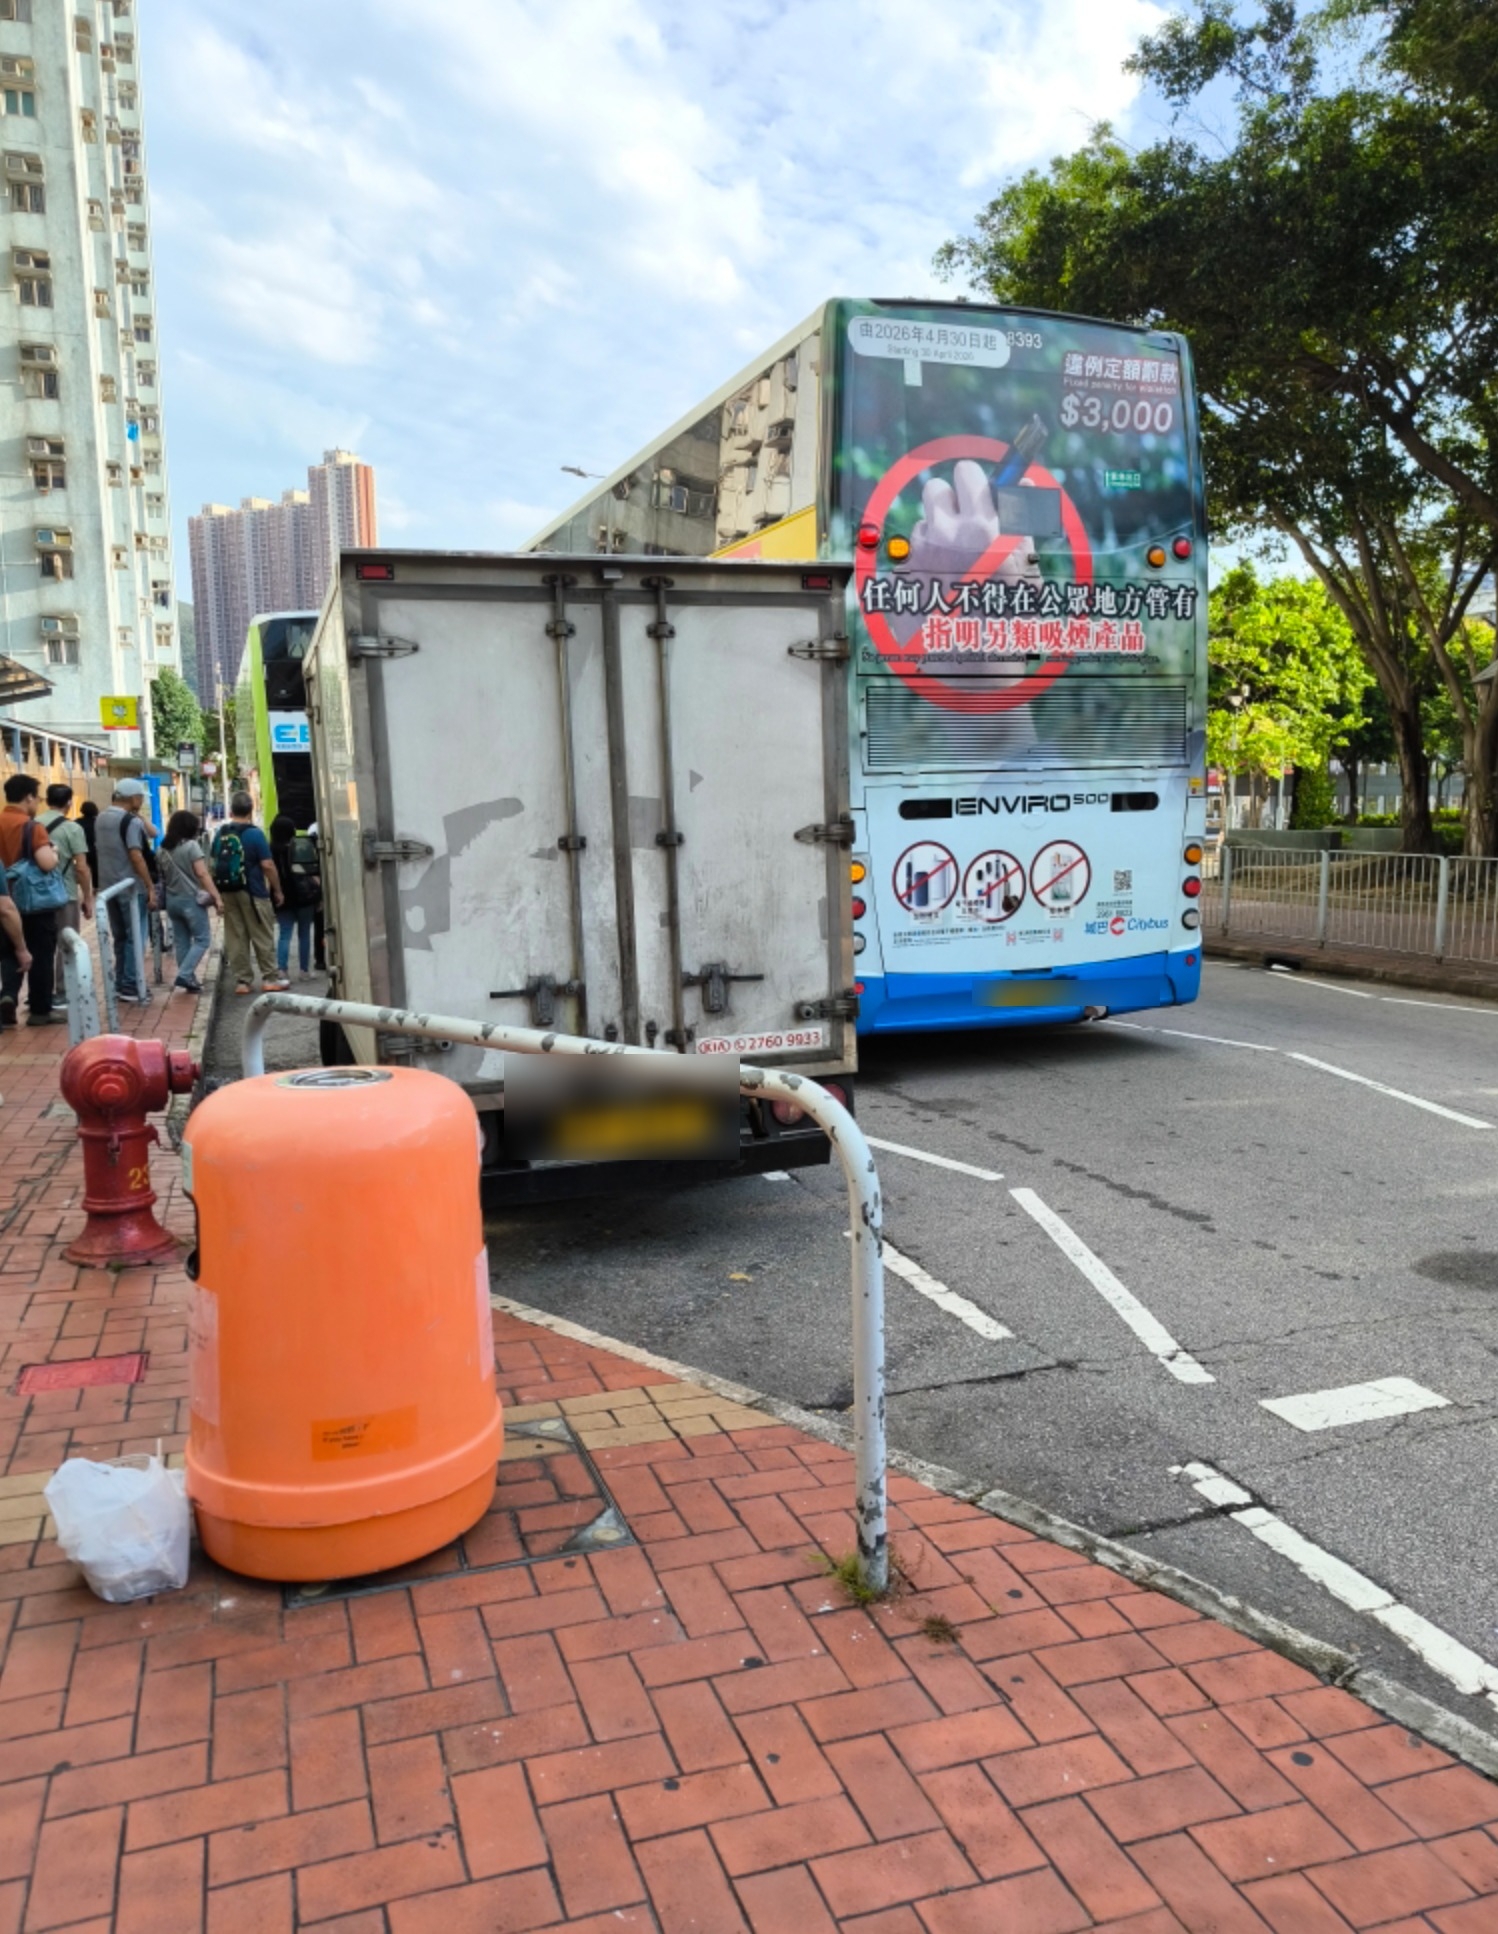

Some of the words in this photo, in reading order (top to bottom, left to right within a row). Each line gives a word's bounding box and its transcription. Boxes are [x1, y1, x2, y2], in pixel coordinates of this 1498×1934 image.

[859, 321, 997, 351] 由2026年4月30日起
[1006, 331, 1042, 349] 8393
[1060, 393, 1173, 432] $3,000
[863, 578, 1197, 618] 任何人不得在公眾地方管有
[923, 617, 1146, 652] 指明另類吸煙產品
[1085, 921, 1108, 935] 城巴
[1127, 918, 1169, 931] Citybus
[700, 1039, 731, 1054] KIA
[748, 1035, 783, 1050] 2760
